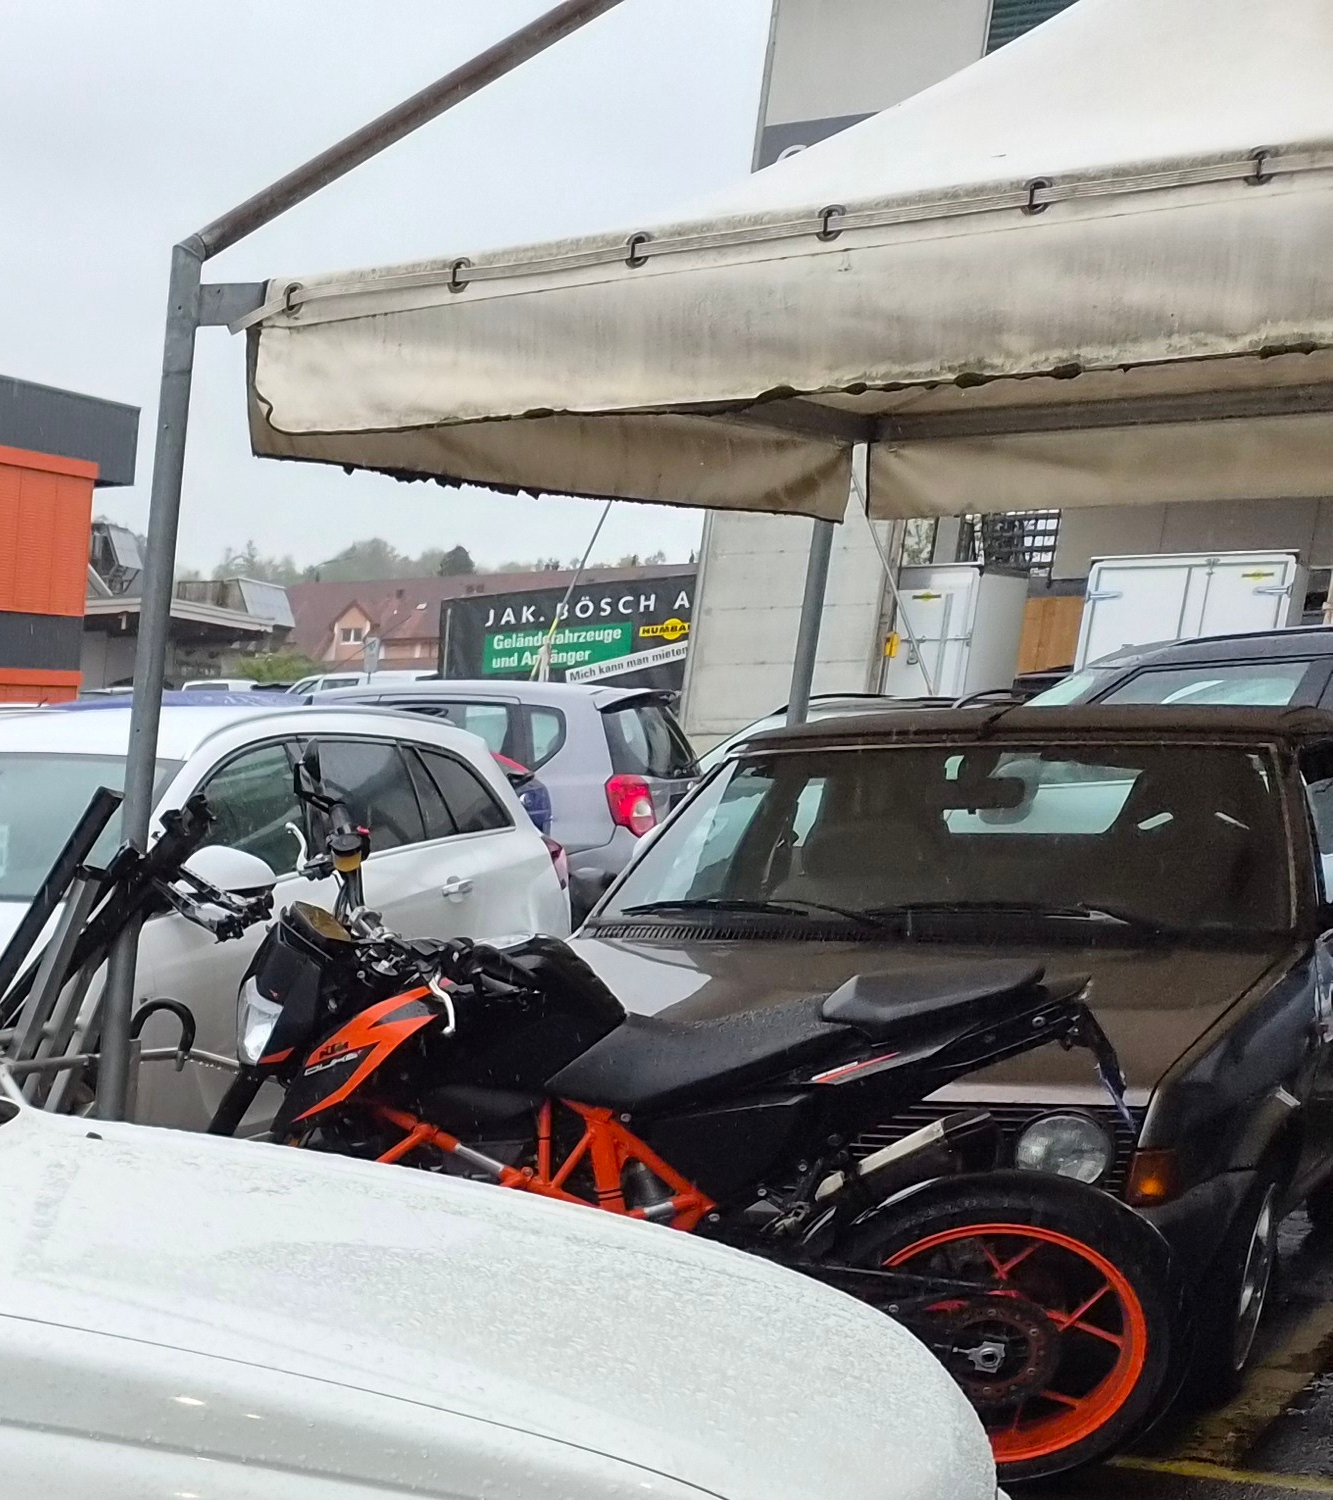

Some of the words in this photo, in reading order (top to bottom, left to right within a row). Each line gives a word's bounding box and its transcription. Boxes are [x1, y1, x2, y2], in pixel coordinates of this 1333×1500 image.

[484, 604, 545, 628] JAK.
[555, 593, 656, 620] BÖSCH
[641, 624, 691, 635] HUMBA
[491, 652, 519, 669] und
[520, 650, 593, 666] Anänger
[569, 667, 596, 681] Mich
[598, 661, 624, 675] kann
[626, 655, 649, 668] man
